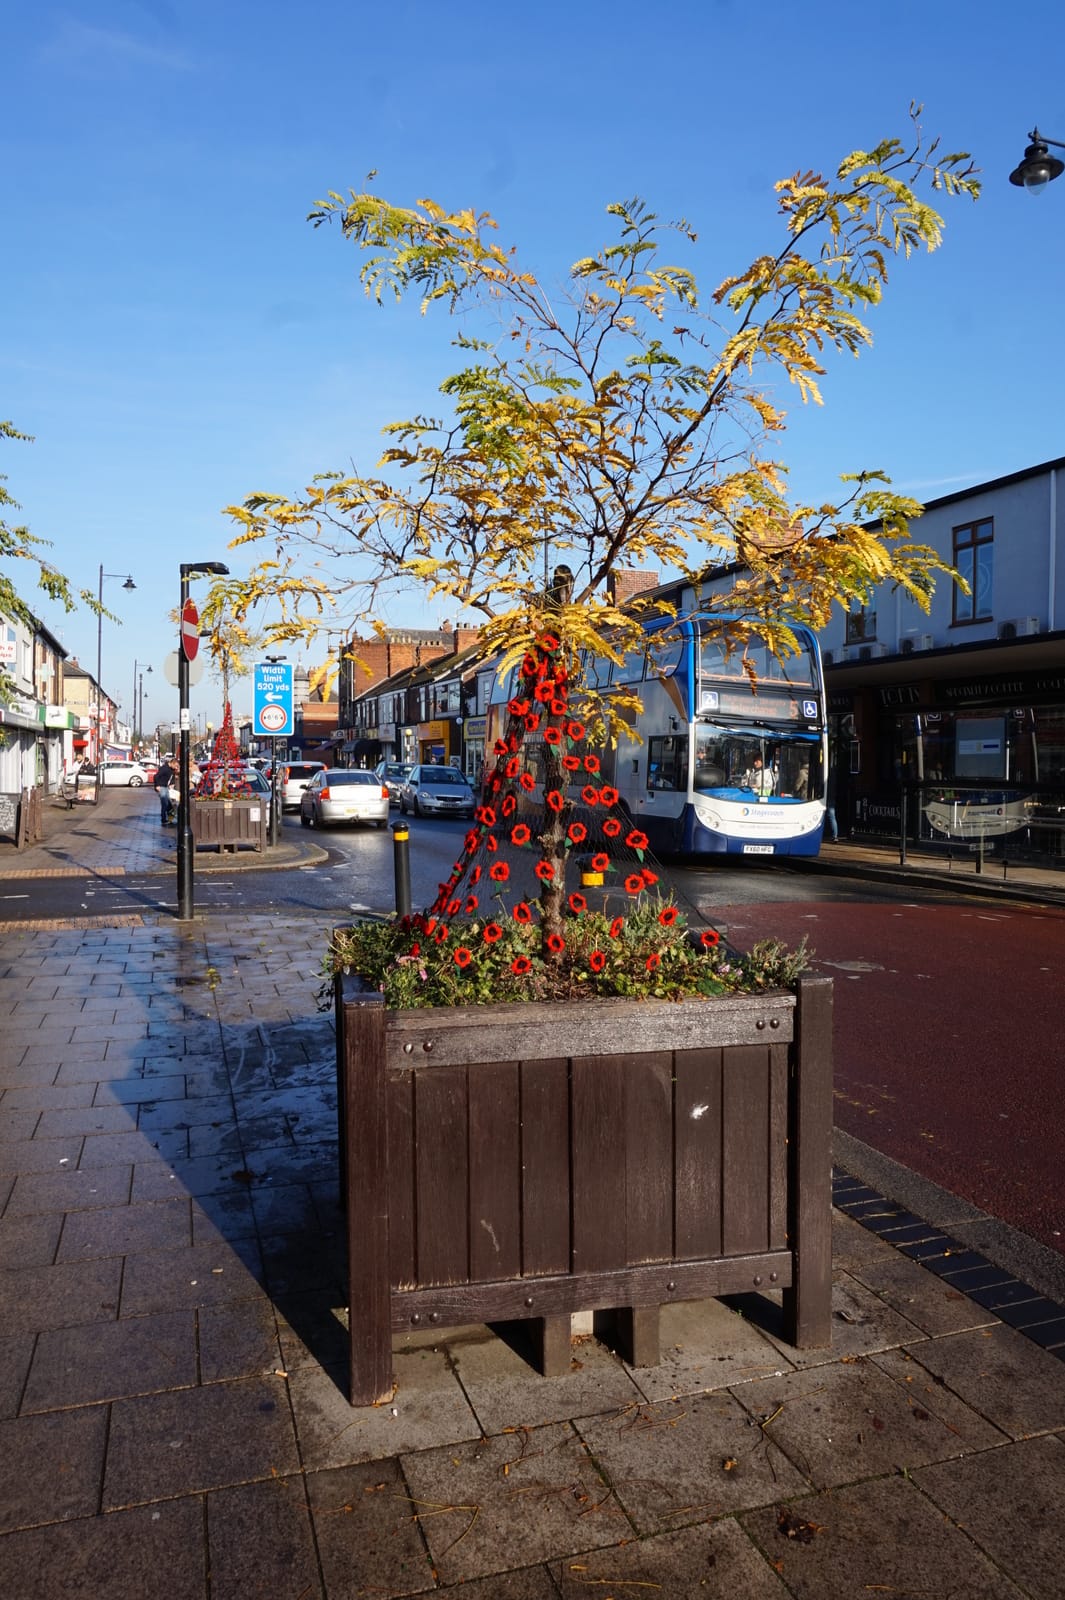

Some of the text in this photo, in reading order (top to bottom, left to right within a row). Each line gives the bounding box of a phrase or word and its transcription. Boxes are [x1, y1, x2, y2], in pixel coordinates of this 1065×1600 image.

[261, 666, 286, 674] Width
[257, 682, 290, 692] 520 yds
[789, 699, 799, 719] 5
